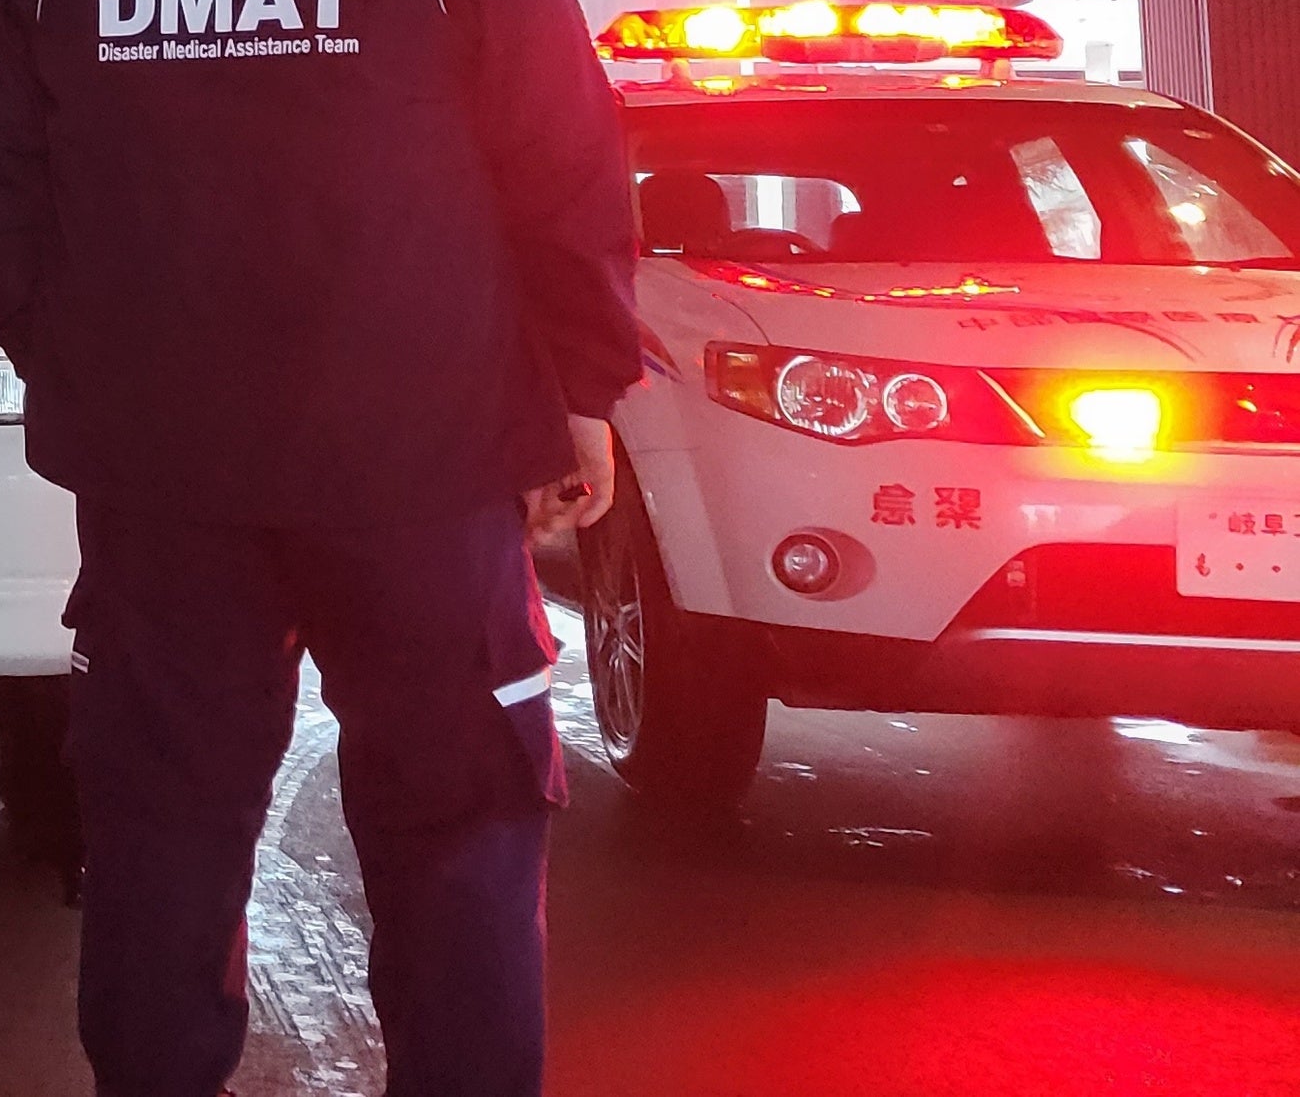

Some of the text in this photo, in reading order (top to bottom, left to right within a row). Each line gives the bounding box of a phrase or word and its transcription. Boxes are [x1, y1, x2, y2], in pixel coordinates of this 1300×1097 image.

[98, 34, 360, 62] Disaster Medical Assistance Team
[1228, 513, 1300, 536] 岐阜
